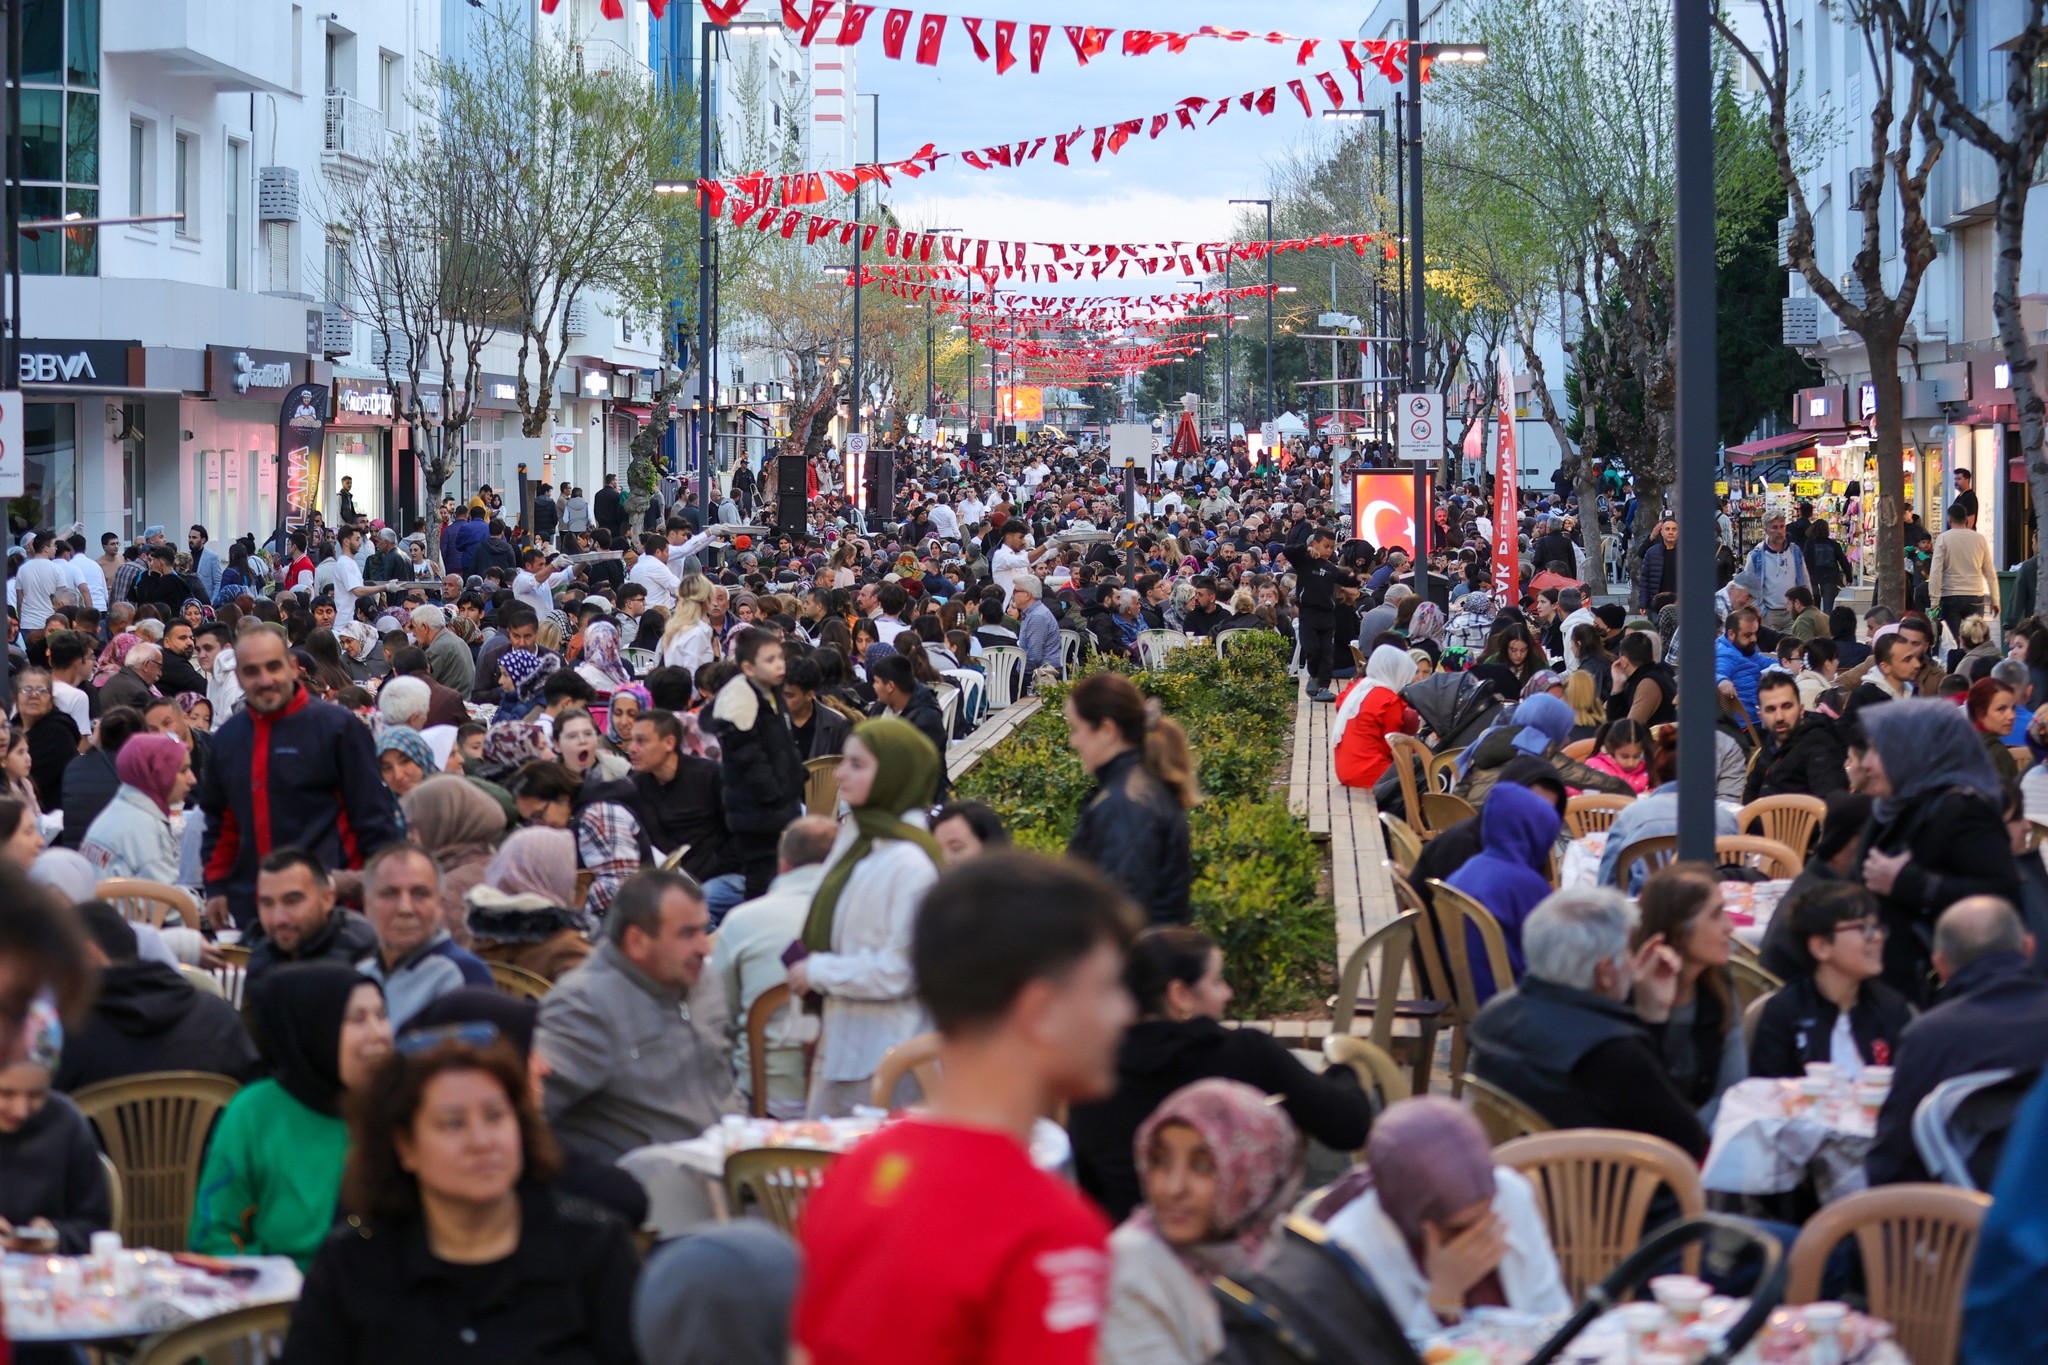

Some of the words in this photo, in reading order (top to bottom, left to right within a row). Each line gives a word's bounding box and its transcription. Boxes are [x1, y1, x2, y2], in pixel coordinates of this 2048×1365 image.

[20, 352, 96, 382] BBVA
[1804, 460, 1812, 470] 25
[1797, 485, 1805, 494] 15
